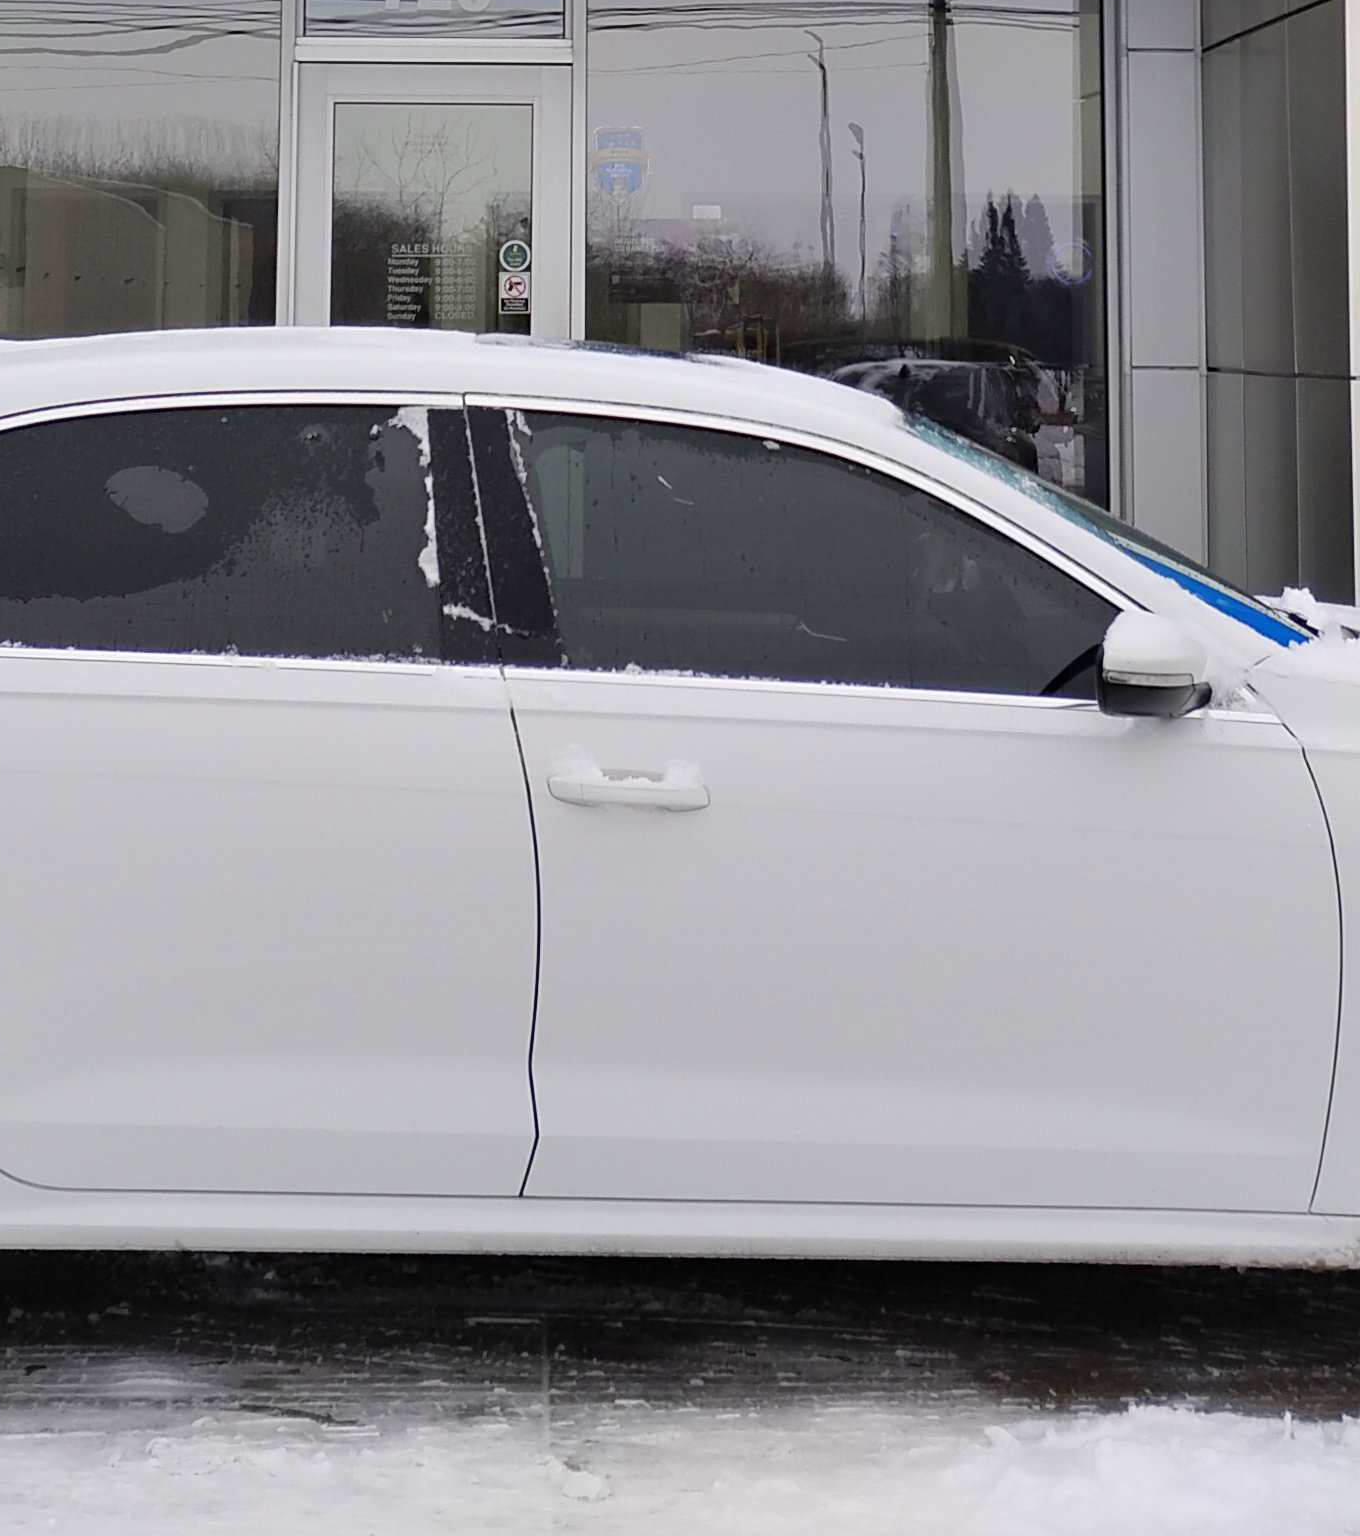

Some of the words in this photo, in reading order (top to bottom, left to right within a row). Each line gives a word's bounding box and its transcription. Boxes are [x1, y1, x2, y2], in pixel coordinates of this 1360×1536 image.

[391, 243, 429, 254] SALES
[432, 243, 472, 254] HOURS
[387, 258, 418, 267] Monday
[387, 267, 419, 276] Tuesday
[387, 276, 432, 285] Wednesday
[387, 285, 423, 294] Thursday
[387, 294, 411, 303] Friday
[387, 303, 421, 312] Saturday
[387, 312, 416, 321] Sunday
[435, 312, 475, 320] CLOSED
